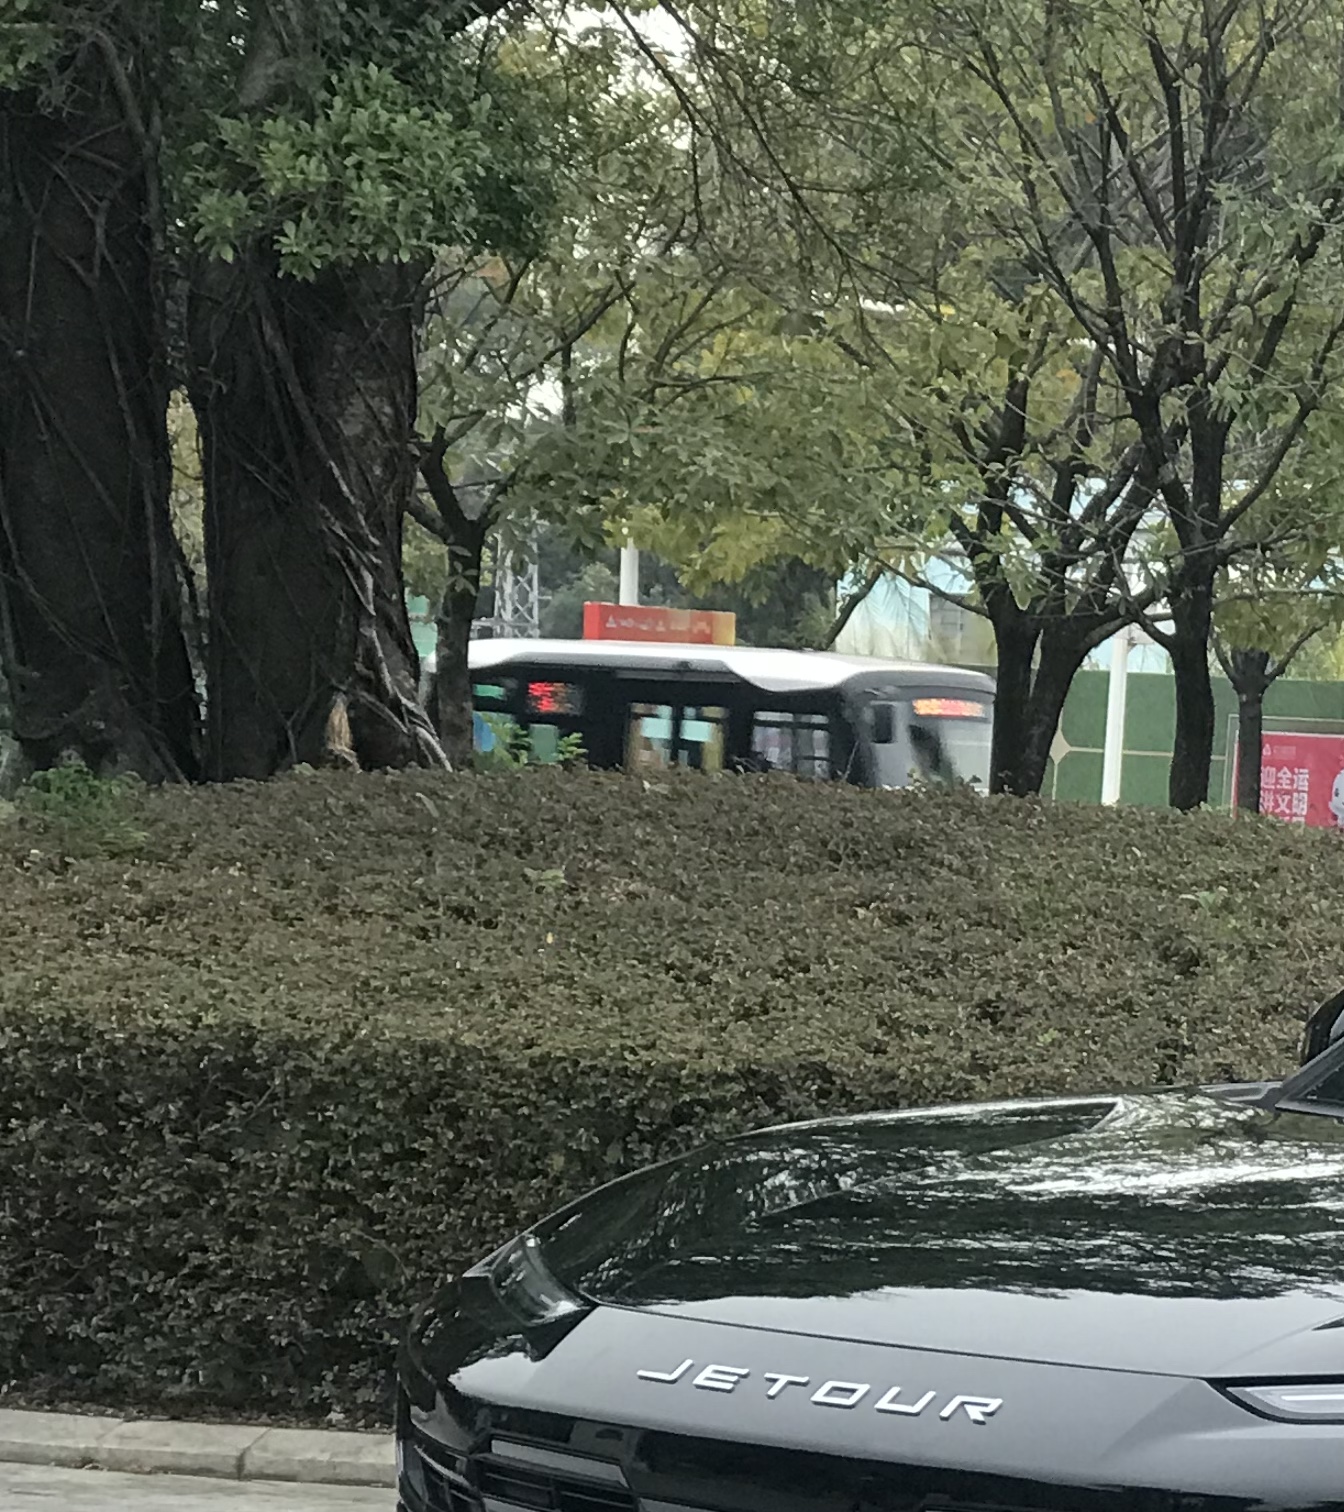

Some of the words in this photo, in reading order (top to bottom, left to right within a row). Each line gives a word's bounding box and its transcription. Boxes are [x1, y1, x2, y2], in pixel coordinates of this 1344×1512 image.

[1261, 766, 1309, 792] 迎全运
[636, 1358, 1003, 1424] JETOUR
